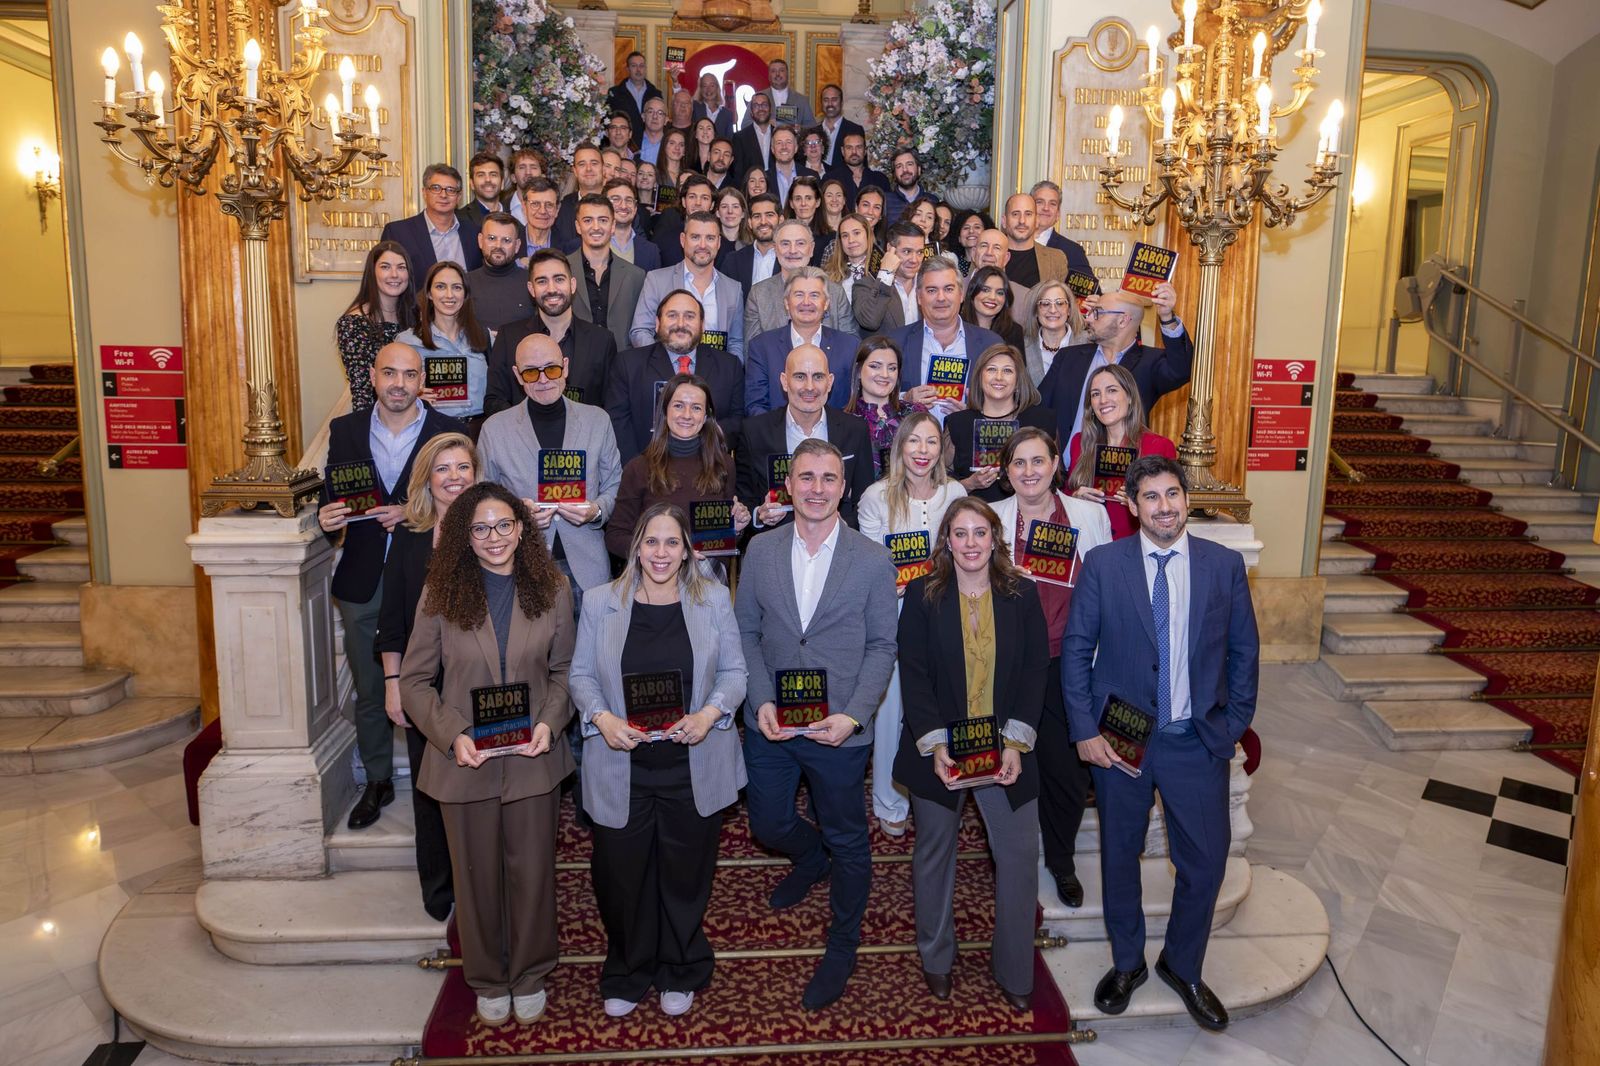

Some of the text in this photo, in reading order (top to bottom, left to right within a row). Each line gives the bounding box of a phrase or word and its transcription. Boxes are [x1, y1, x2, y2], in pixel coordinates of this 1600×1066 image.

[1136, 248, 1170, 268] SABOR
[1134, 261, 1147, 269] DEL
[1151, 265, 1166, 274] AÑO
[1069, 274, 1094, 290] SABOR
[700, 334, 724, 345] ABOR
[430, 362, 462, 374] SABOR
[933, 360, 964, 373] SABOR
[438, 386, 466, 398] 2026
[938, 386, 960, 398] 026
[980, 425, 1012, 437] SABOR
[544, 455, 581, 468] SABOR
[1100, 450, 1132, 465] SABOR
[331, 466, 371, 484] SABOR
[544, 483, 581, 500] 2026
[1098, 479, 1121, 492] 202
[347, 494, 376, 512] 026
[695, 506, 730, 518] SABOR
[890, 536, 925, 552] SABOR
[1034, 526, 1072, 547] SABOR
[702, 539, 725, 550] 2026
[1033, 540, 1047, 548] DEL
[1052, 544, 1070, 553] AÑO
[1029, 558, 1066, 576] 2026
[631, 680, 674, 697] SABOR
[781, 675, 821, 690] SABOR
[479, 690, 523, 710] SABOR
[480, 706, 523, 718] DEL AÑO
[645, 711, 680, 727] 2026
[783, 706, 824, 724] 2026
[1109, 703, 1147, 732] SABOR
[953, 723, 992, 742] SABOR
[1107, 716, 1143, 740] DEL AÑO
[495, 730, 525, 745] 2026
[975, 738, 993, 746] AÑO
